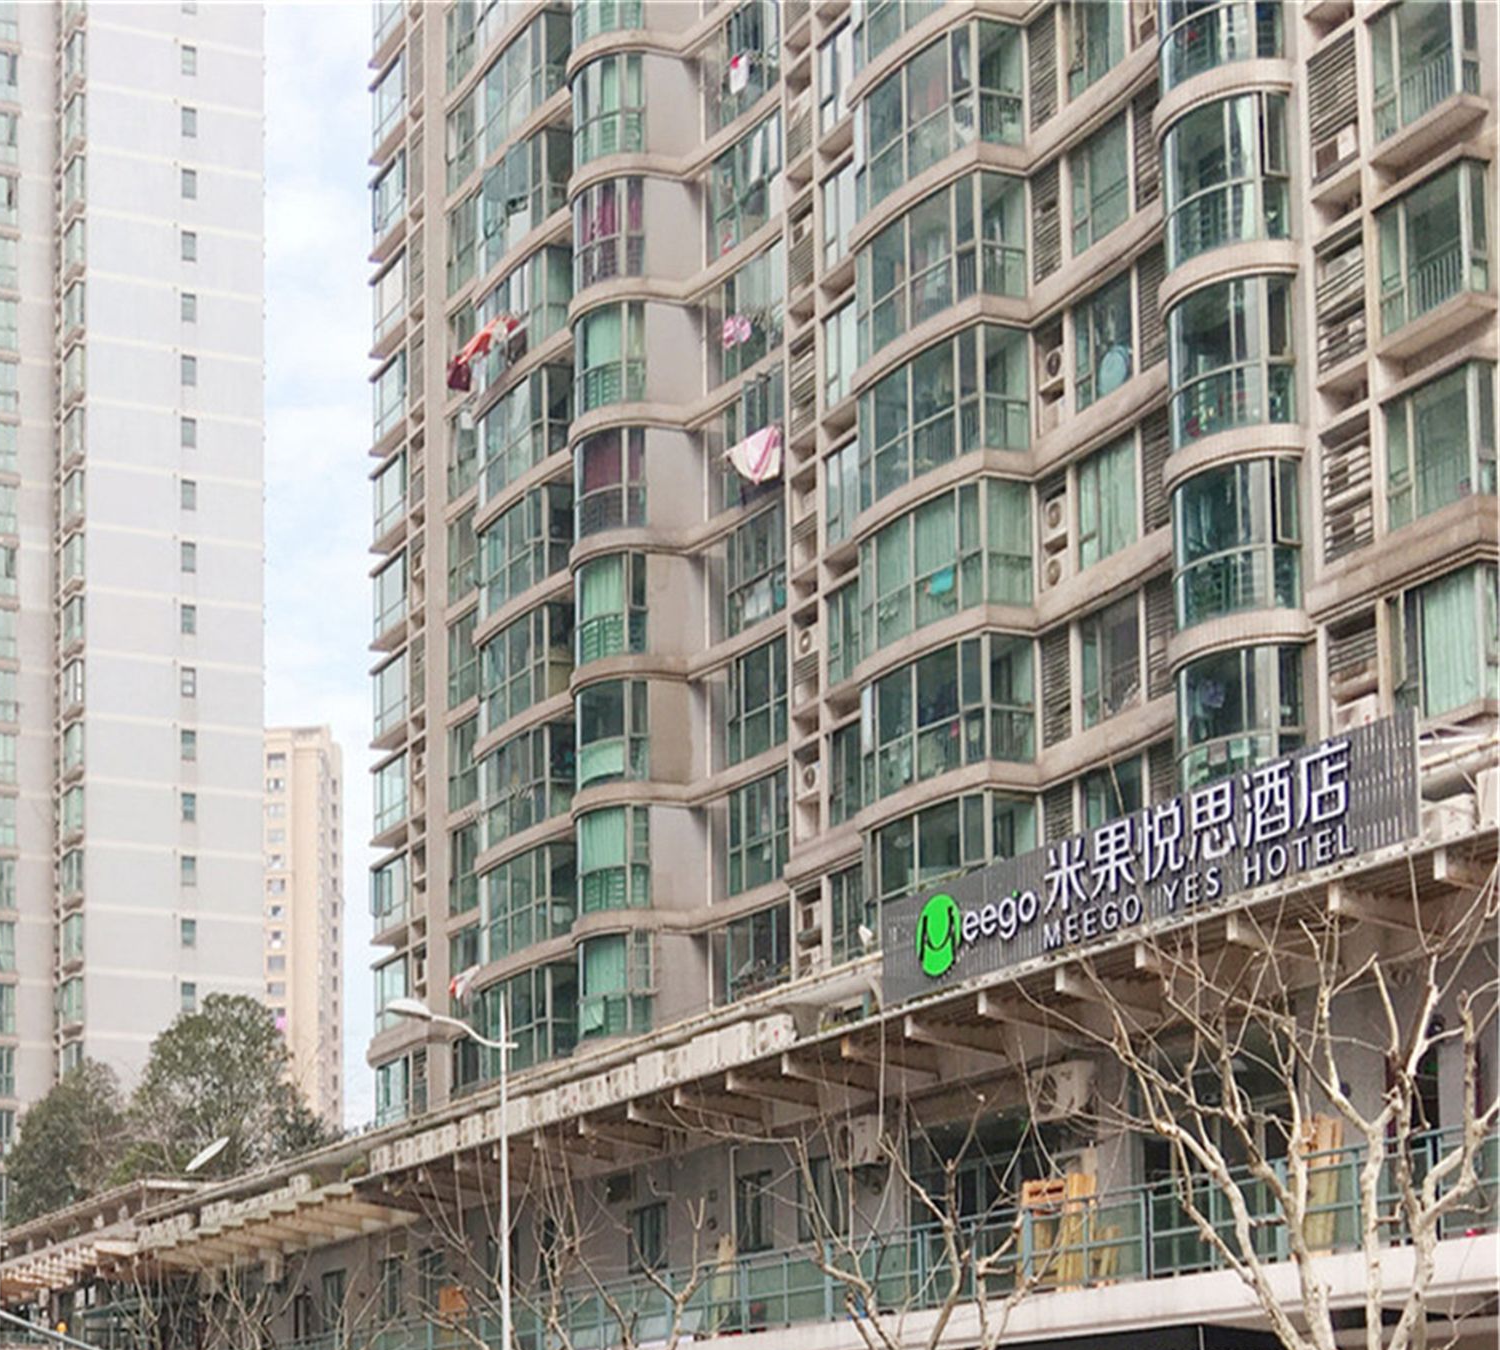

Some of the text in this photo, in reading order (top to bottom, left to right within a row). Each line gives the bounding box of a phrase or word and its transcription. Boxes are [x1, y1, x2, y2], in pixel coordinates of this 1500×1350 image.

[1043, 740, 1352, 915] 米果悦思酒店
[1043, 825, 1356, 950] MEEGO YES HOTEL
